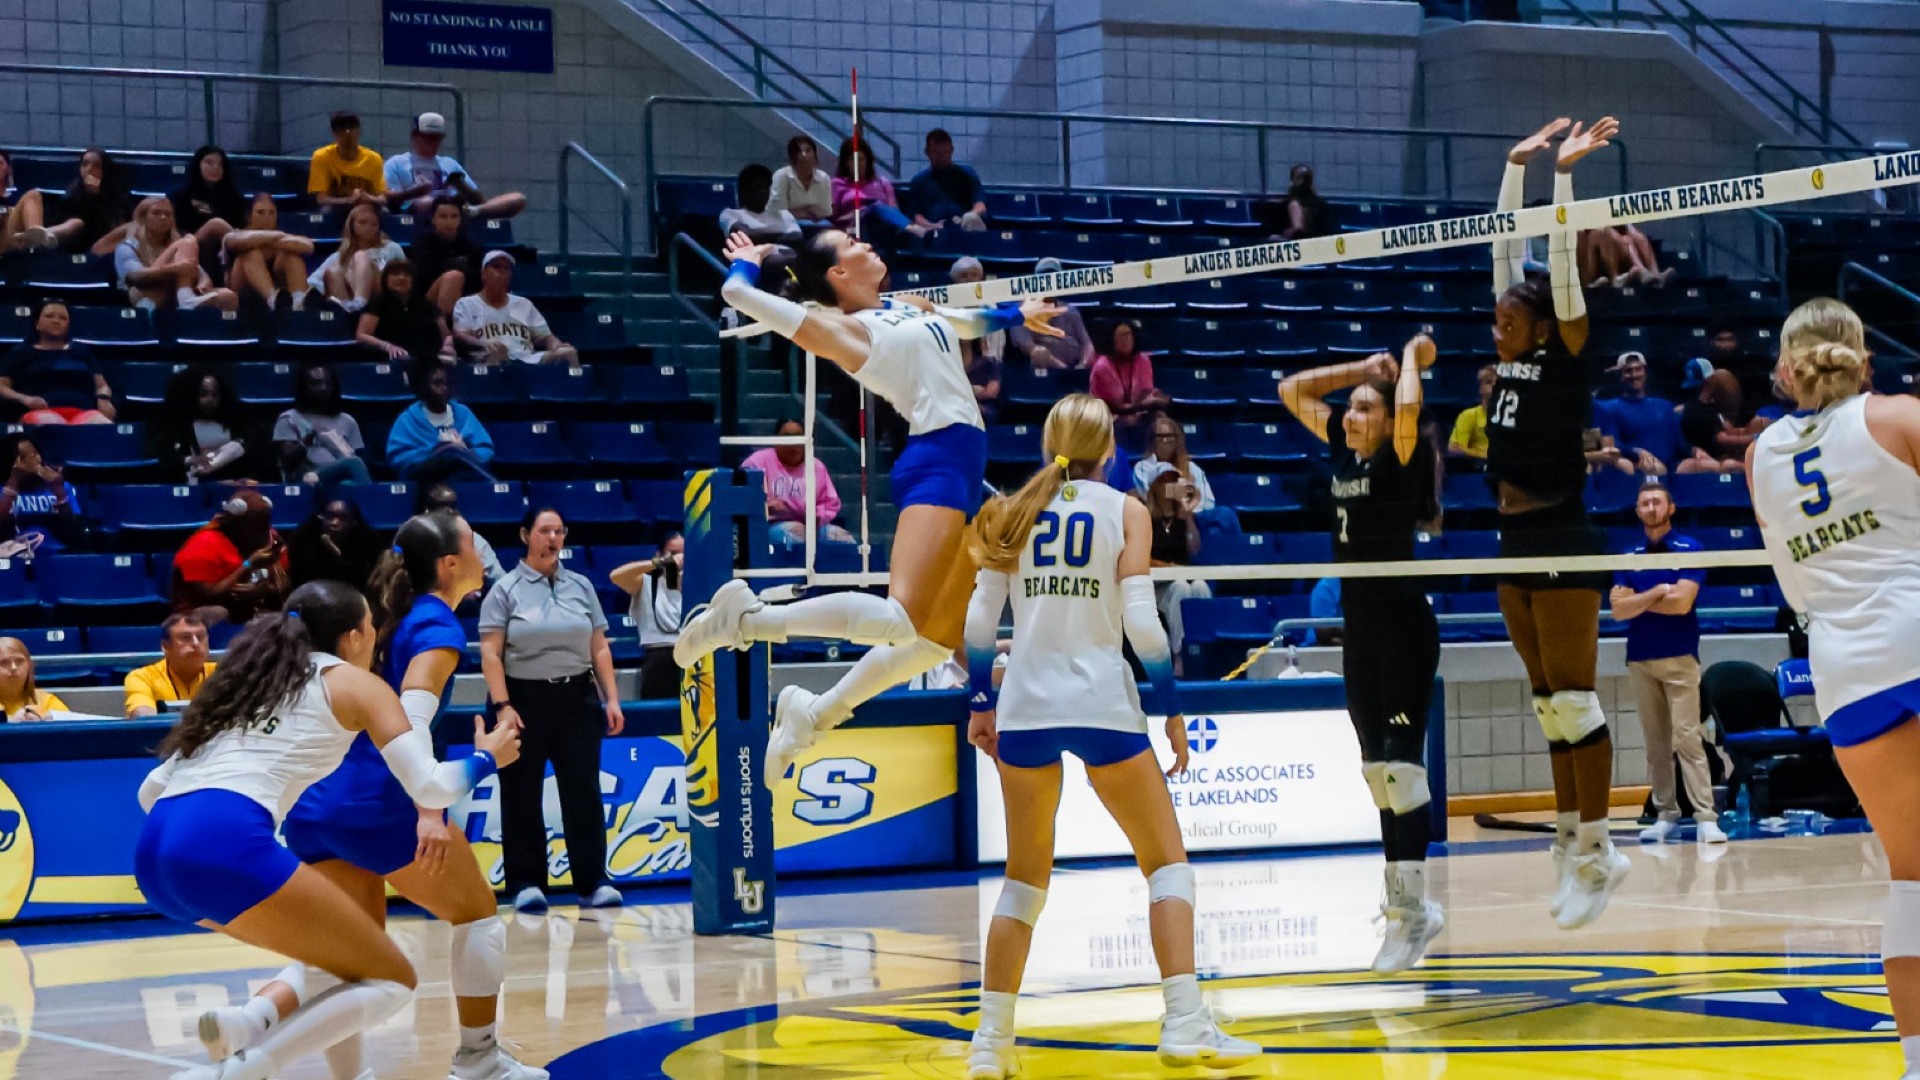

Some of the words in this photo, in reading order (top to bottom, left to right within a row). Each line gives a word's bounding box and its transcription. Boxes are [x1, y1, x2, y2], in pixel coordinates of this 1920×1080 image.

[389, 11, 410, 24] NO
[413, 13, 486, 28] STANDING
[489, 17, 504, 28] IN
[508, 19, 546, 32] AISLE
[428, 42, 478, 56] THANK
[480, 45, 511, 58] YOU
[1609, 189, 1672, 218] LANDER
[1677, 177, 1765, 209] BEARCATS
[1381, 224, 1436, 250] LANDER
[1440, 212, 1517, 240] BEARCATS
[1184, 247, 1232, 274] LANDER
[1235, 243, 1301, 269] BEARCATS
[1010, 273, 1052, 296] LANDER
[1056, 267, 1114, 290] BEARCATS
[924, 321, 951, 353] 11
[1491, 389, 1519, 428] 12
[1793, 446, 1832, 517] 5
[1033, 510, 1095, 568] 20
[1336, 506, 1349, 544] 7
[1786, 508, 1881, 563] BEARCATS
[1024, 575, 1100, 599] BEARCATS
[1785, 670, 1813, 683] Lan
[737, 746, 754, 795] sports
[1214, 763, 1315, 783] ASSOCIATES
[1189, 787, 1278, 807] LAKELANDS
[739, 797, 754, 858] imports
[1228, 819, 1278, 838] Group
[733, 867, 765, 914] LU
